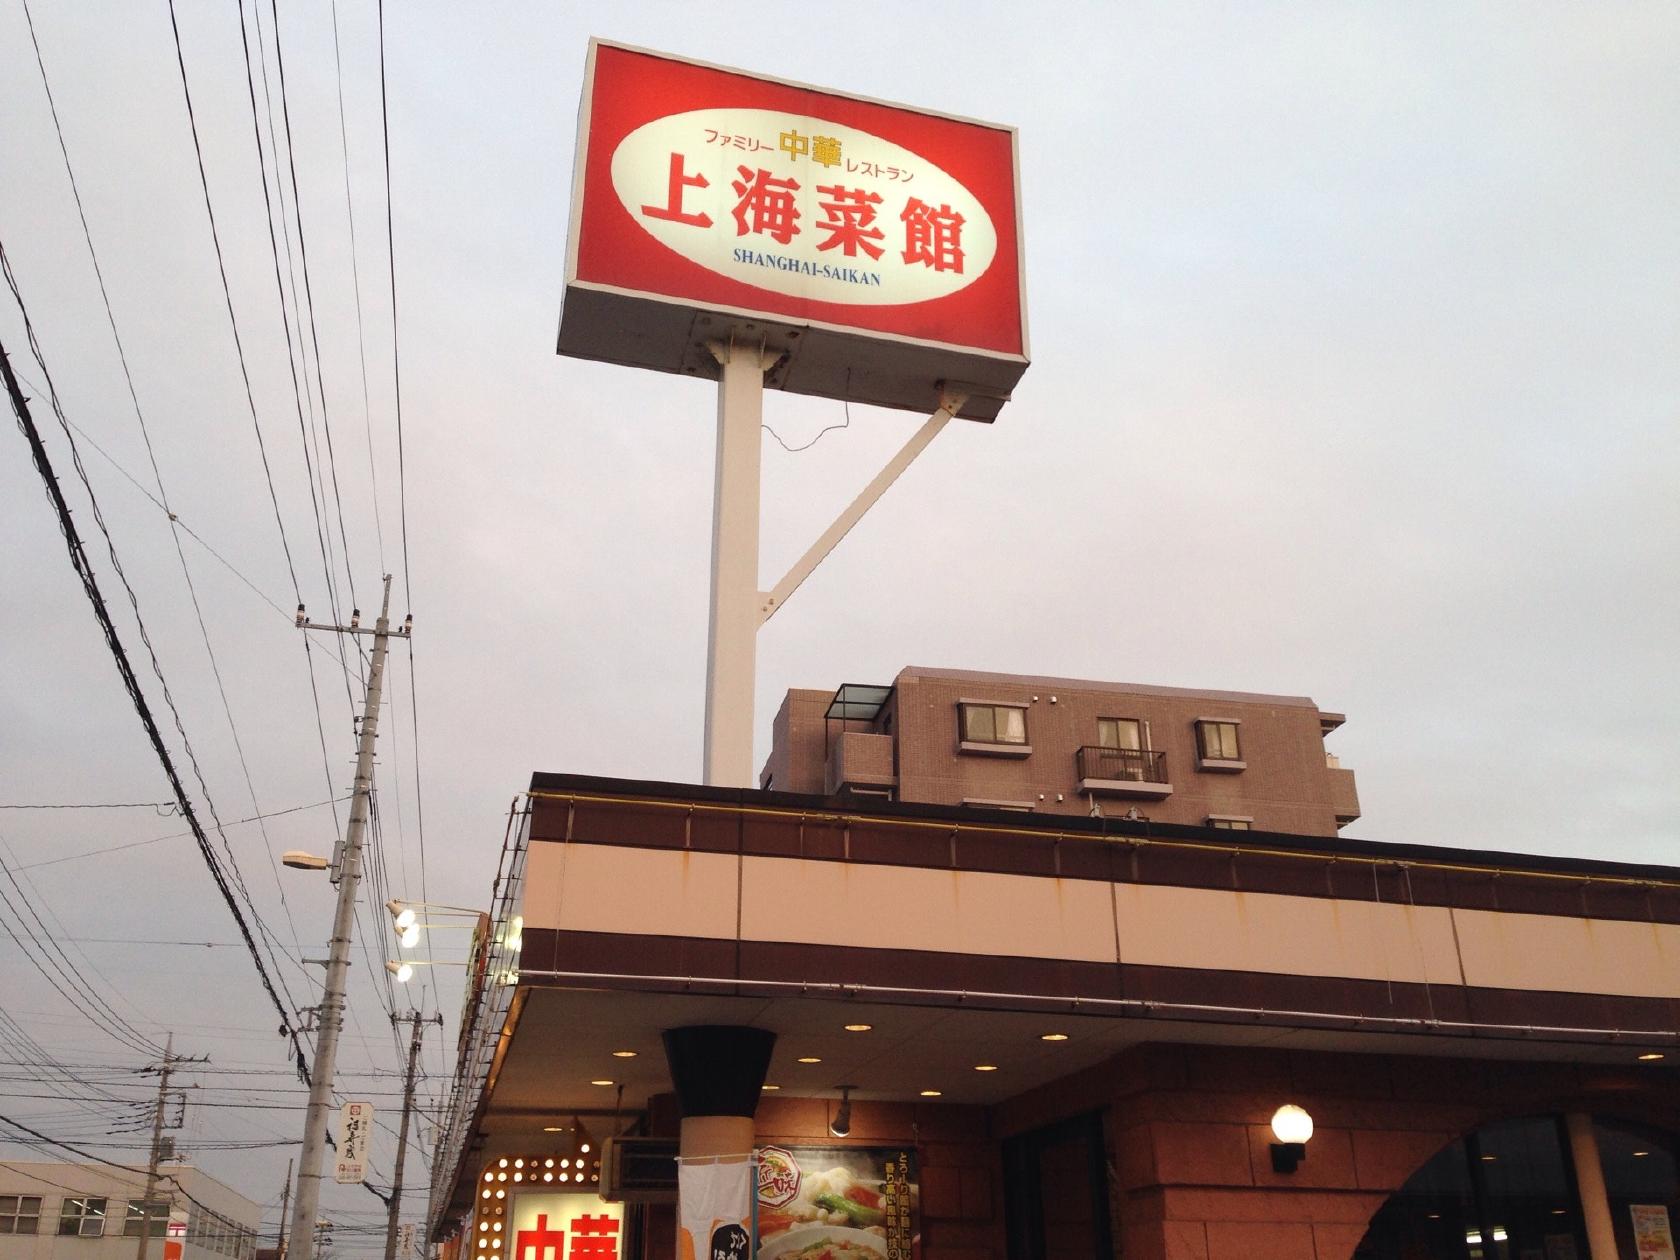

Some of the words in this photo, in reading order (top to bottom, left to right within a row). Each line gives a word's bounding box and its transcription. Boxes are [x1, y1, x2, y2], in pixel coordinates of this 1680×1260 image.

[704, 129, 774, 152] ファミリー
[779, 129, 841, 168] 中華
[846, 158, 914, 182] レストラン
[641, 152, 967, 275] 上海菜館
[733, 248, 881, 287] SHANGHAI-SAIKAN
